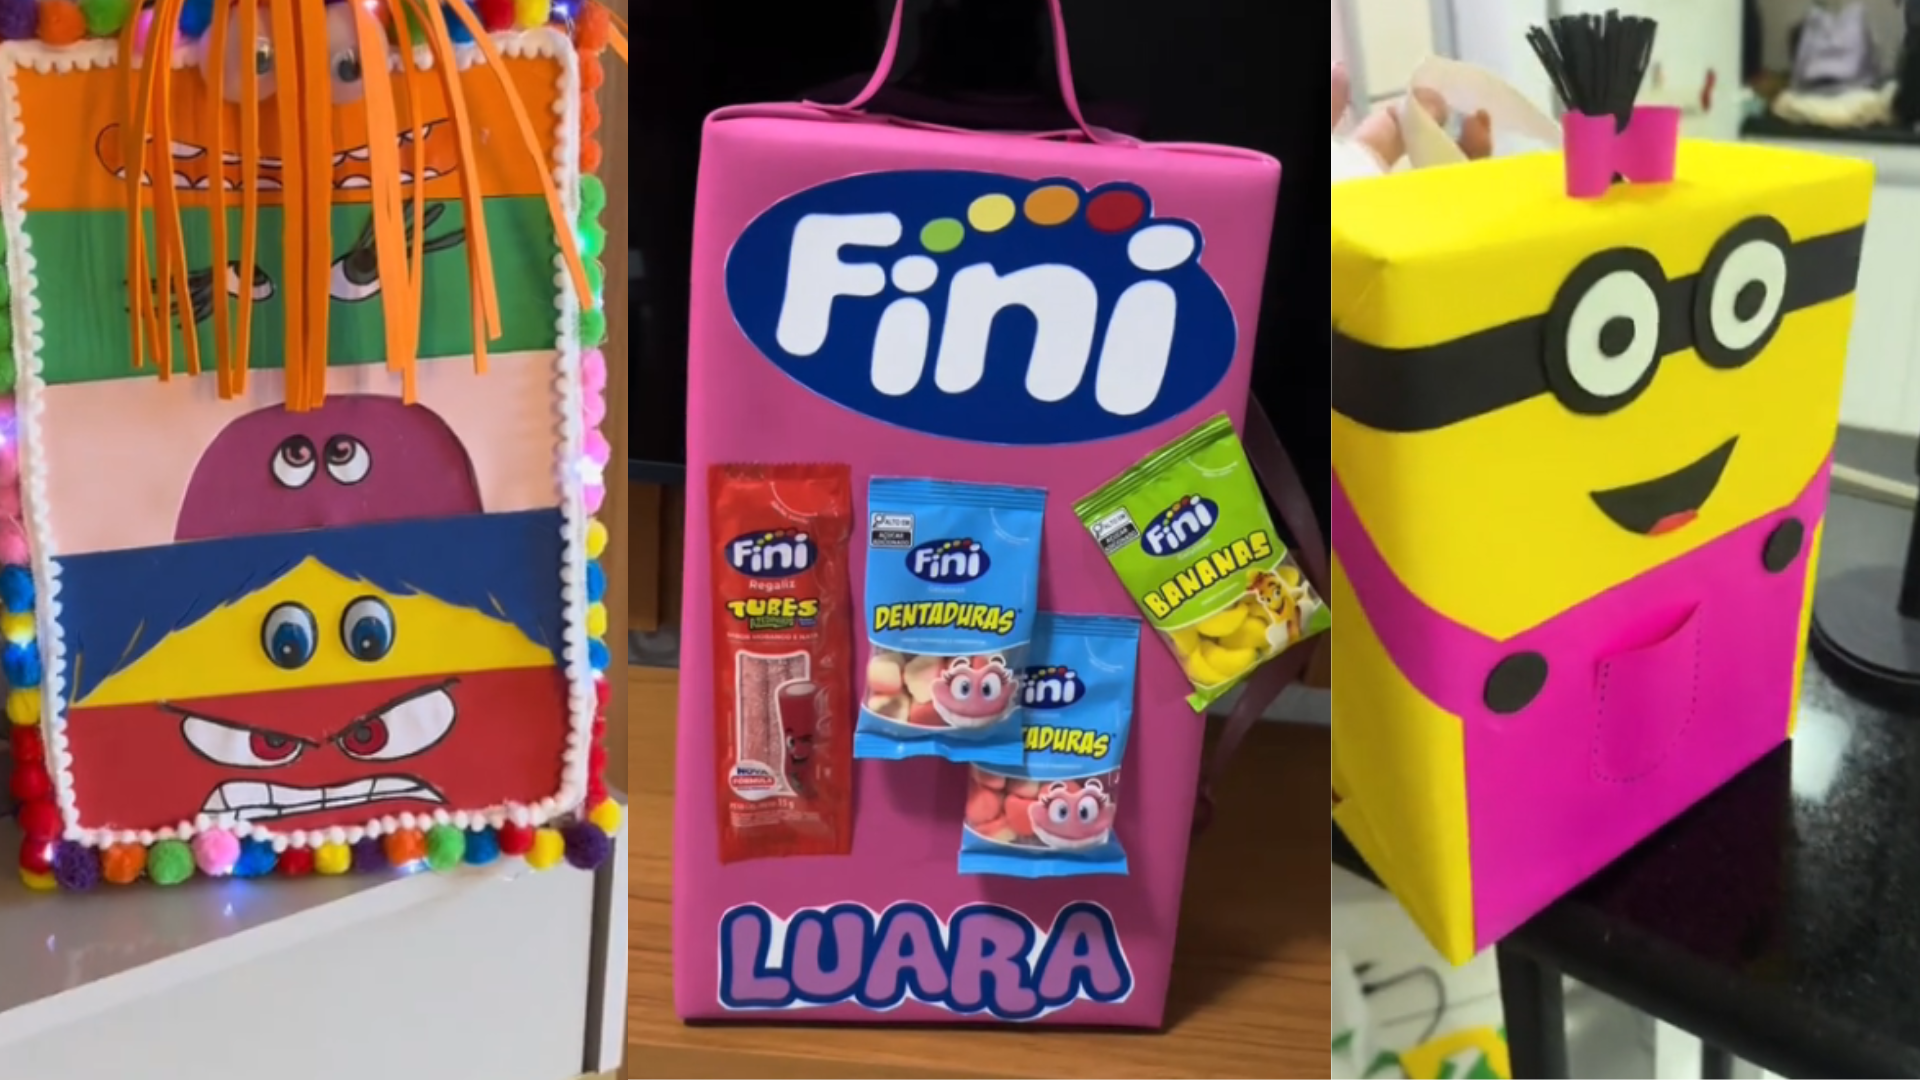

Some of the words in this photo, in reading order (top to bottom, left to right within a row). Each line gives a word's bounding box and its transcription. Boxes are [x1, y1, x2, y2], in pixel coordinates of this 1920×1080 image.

[776, 211, 1196, 416] Fini
[1145, 495, 1213, 555] Fini
[733, 532, 809, 573] Fini
[914, 542, 982, 579] Fini
[749, 579, 796, 593] Regaliz
[1144, 531, 1272, 620] BANANAS
[727, 597, 819, 619] TUBES
[873, 600, 1016, 635] DENTADURAS
[1021, 671, 1076, 704] ini
[1022, 725, 1111, 758] ADURAS
[721, 902, 1132, 1021] LUARA
